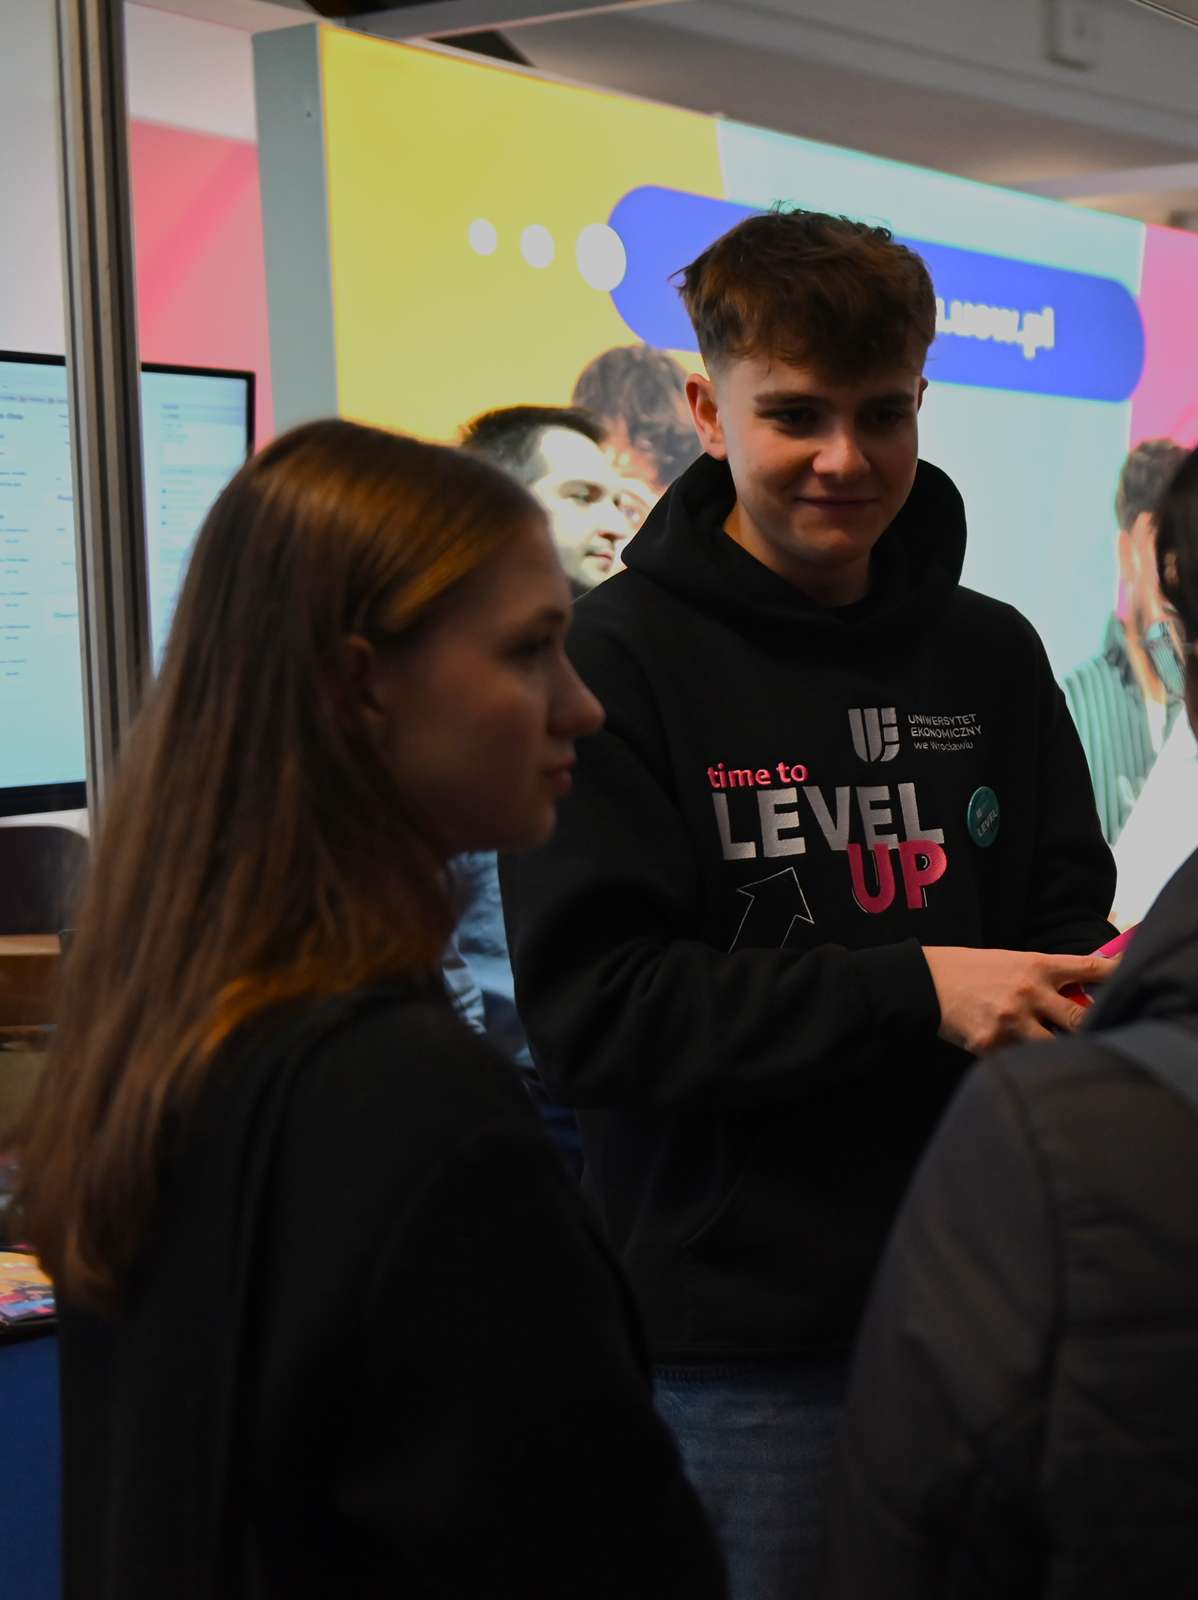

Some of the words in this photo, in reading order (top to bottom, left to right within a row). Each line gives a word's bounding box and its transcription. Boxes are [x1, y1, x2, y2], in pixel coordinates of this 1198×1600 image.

[908, 713, 977, 726] UNIWERSYTET
[911, 725, 982, 738] EKONOMICZNY
[914, 742, 929, 750] we
[706, 761, 772, 789] time
[776, 760, 810, 785] to
[712, 782, 945, 861] LEVEL
[847, 840, 950, 914] UP
